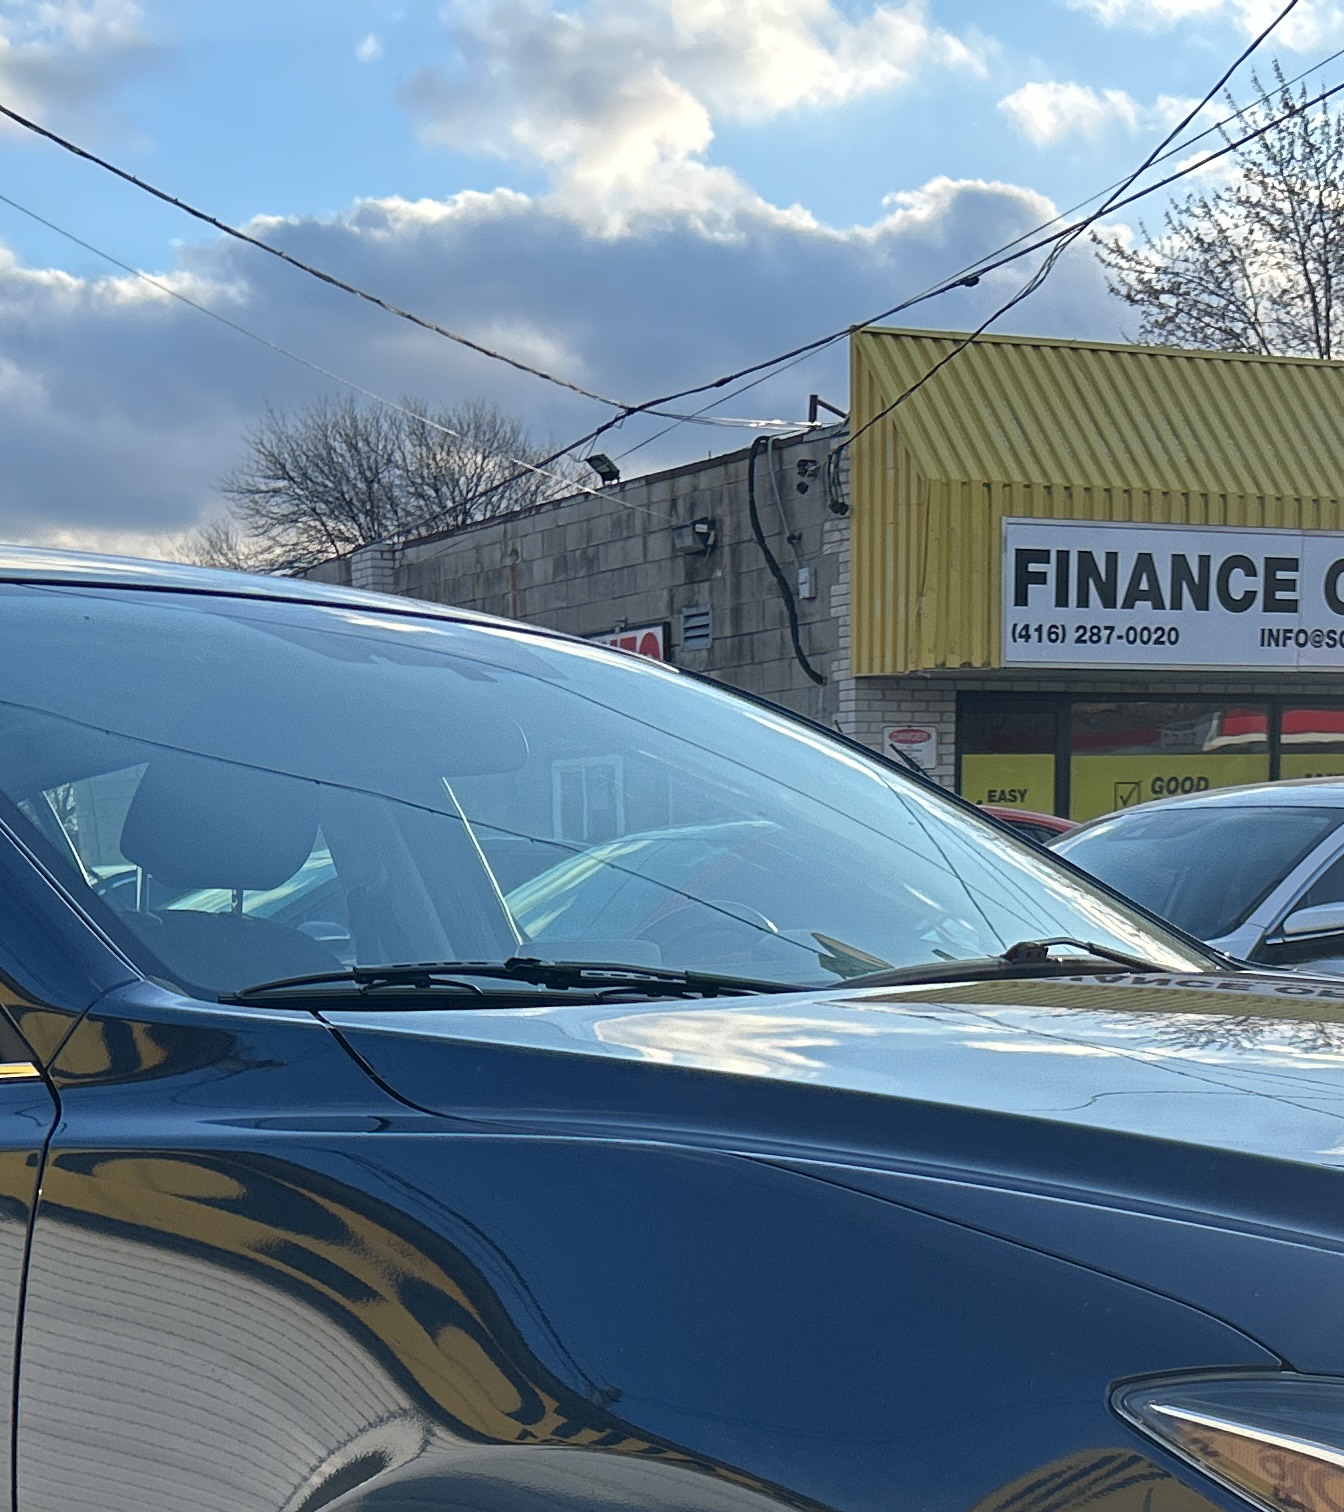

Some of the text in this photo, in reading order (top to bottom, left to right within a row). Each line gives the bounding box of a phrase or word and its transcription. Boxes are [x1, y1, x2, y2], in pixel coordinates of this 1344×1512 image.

[1012, 547, 1301, 613] FINANCE
[1010, 622, 1068, 644] (416)
[1074, 625, 1181, 646] 287-0020
[1151, 776, 1210, 795] GOOD
[987, 789, 1029, 804] EASY
